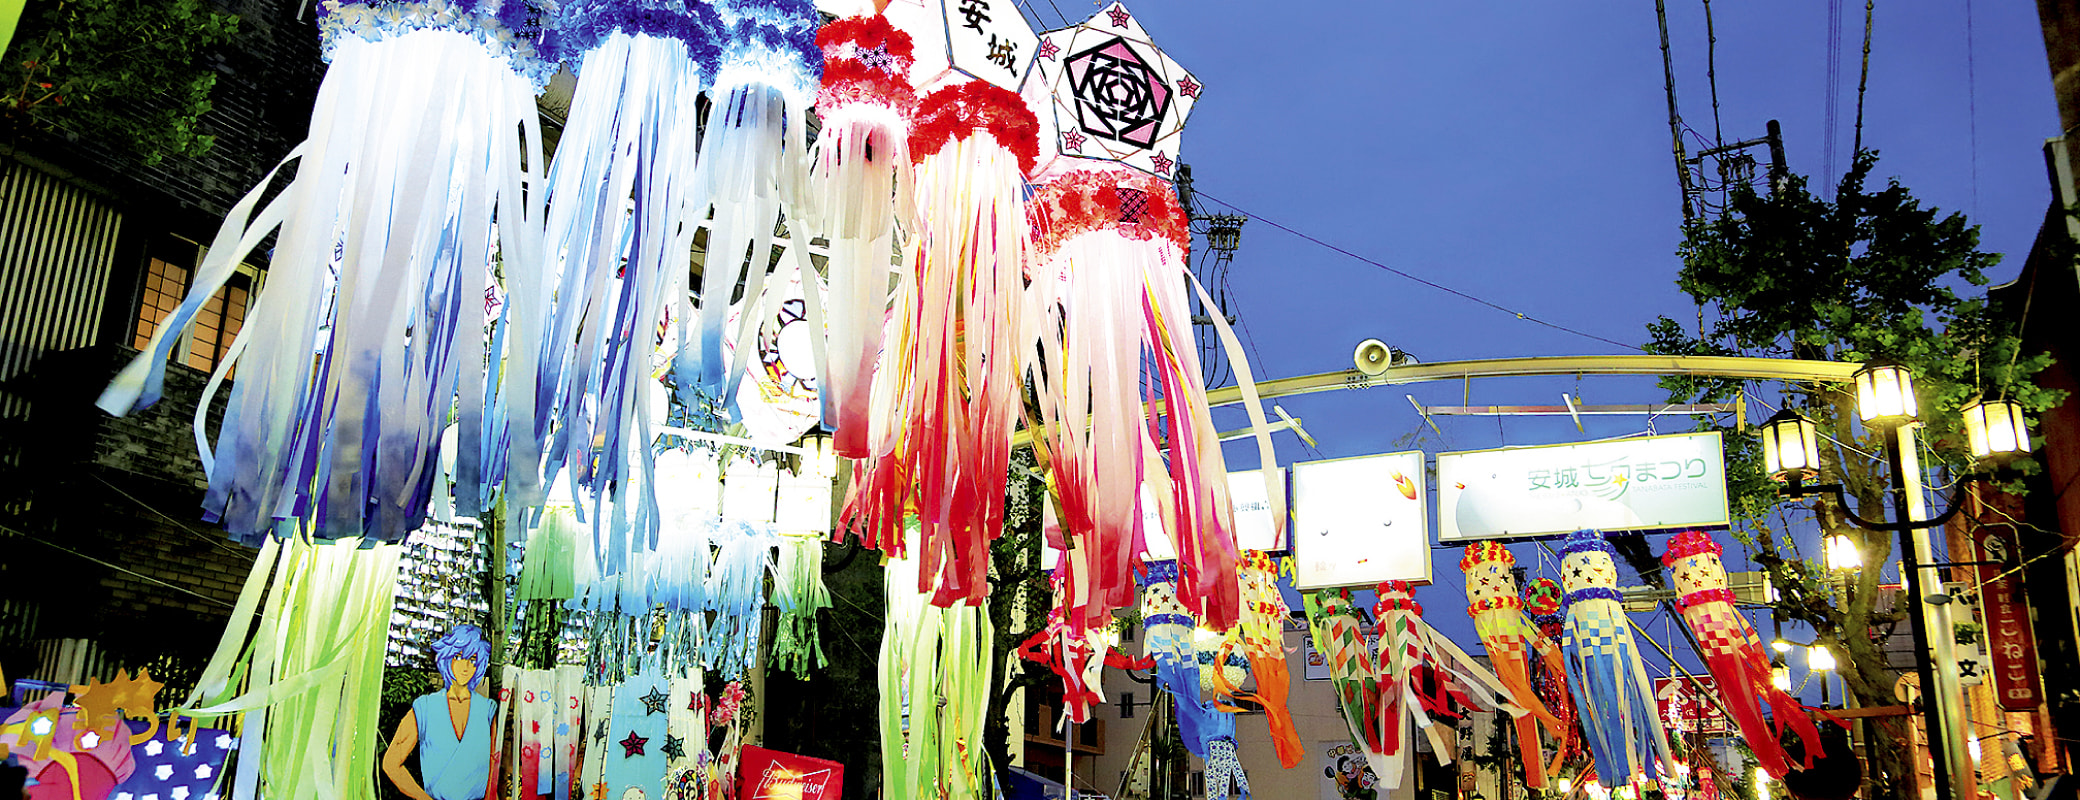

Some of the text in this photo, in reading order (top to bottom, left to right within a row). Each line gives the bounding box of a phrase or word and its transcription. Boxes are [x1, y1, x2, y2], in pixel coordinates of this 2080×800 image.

[958, 0, 1018, 78] 安城
[1528, 456, 1706, 501] 安城七夕まつり
[1673, 481, 1708, 490] FESTIVAL
[2000, 619, 2026, 681] こねこ
[762, 768, 824, 795] Budweiser
